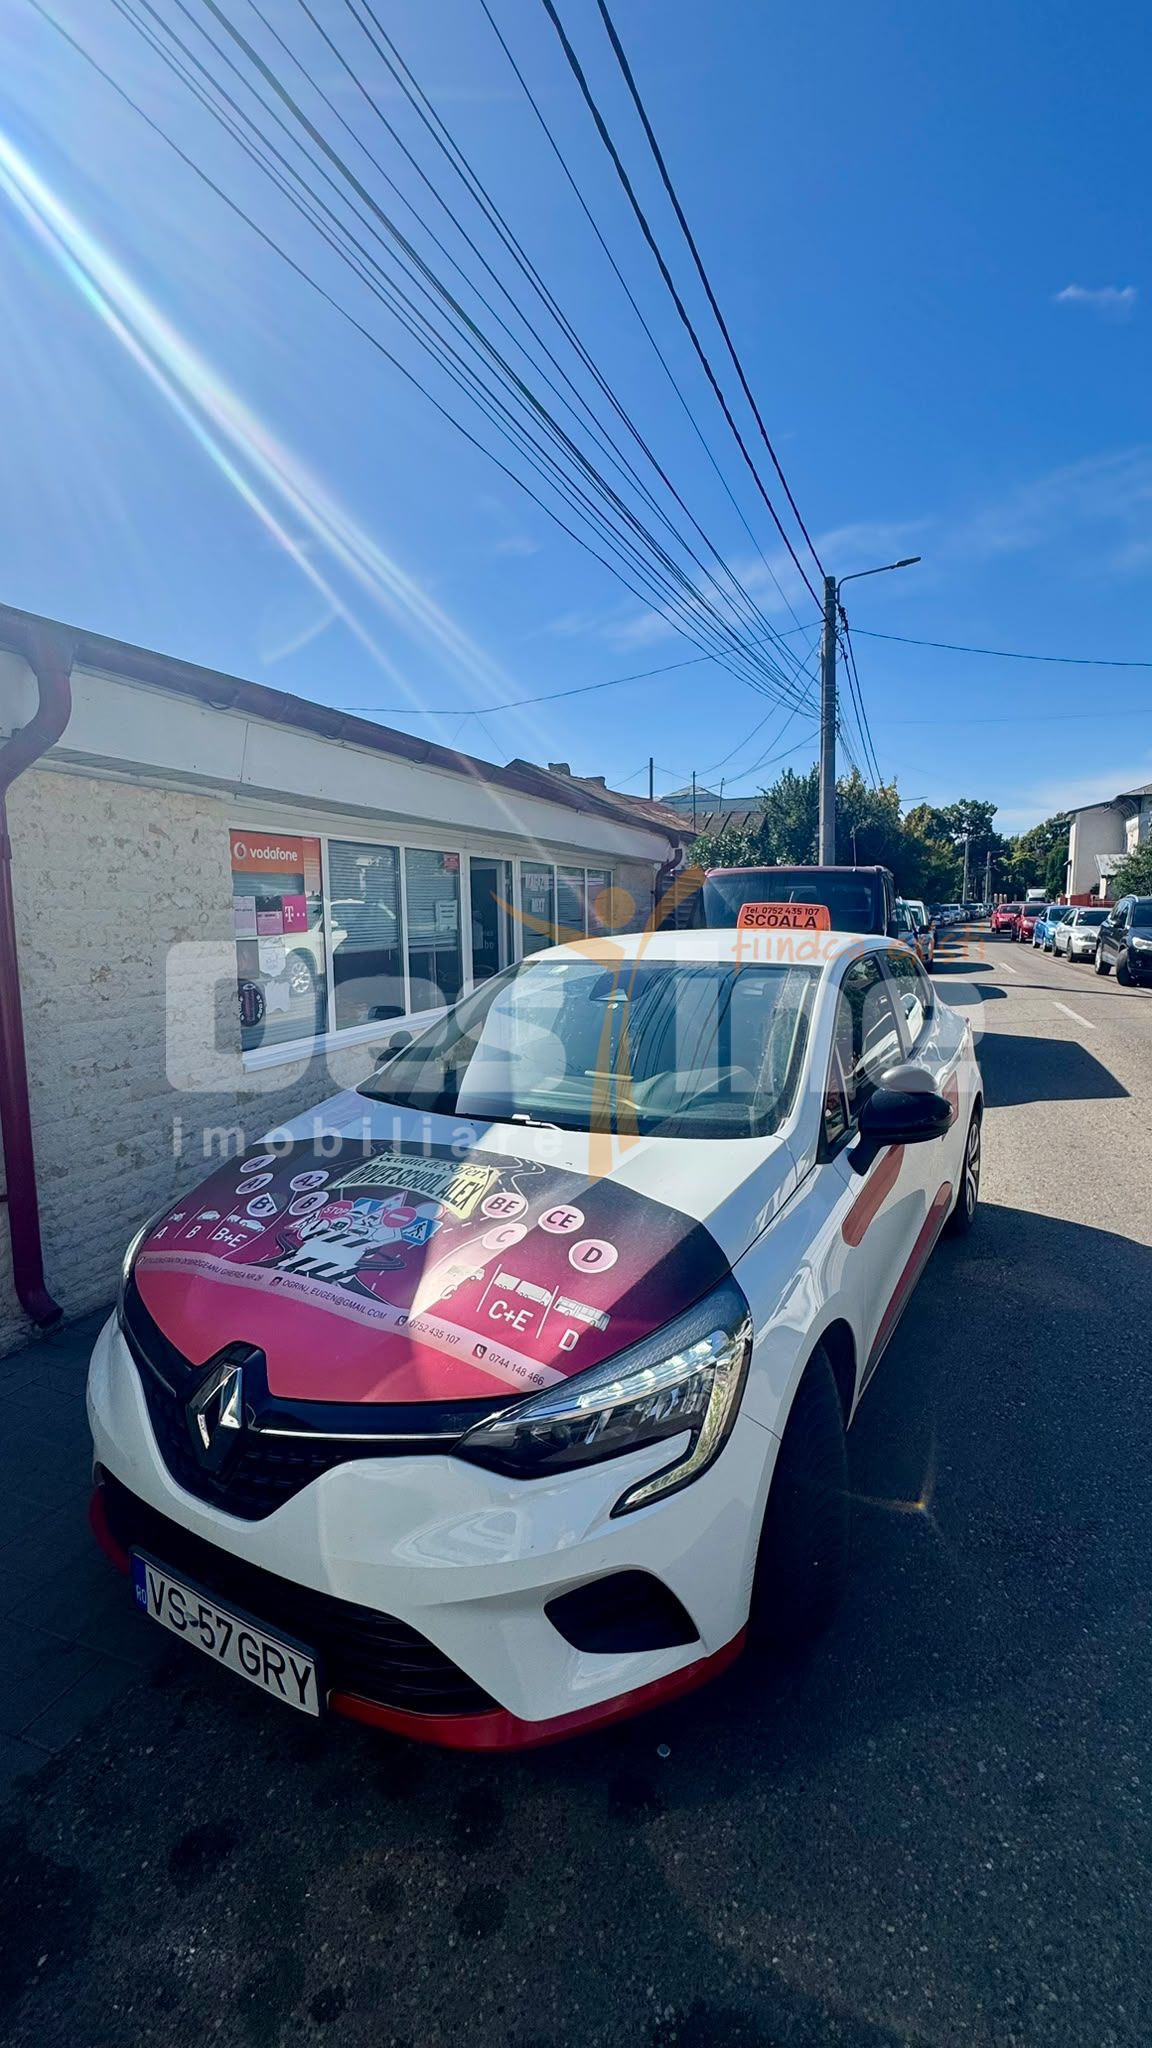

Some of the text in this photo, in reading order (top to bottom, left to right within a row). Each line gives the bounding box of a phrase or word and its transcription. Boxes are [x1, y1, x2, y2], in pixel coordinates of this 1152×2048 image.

[249, 846, 298, 861] vodafone
[746, 906, 759, 914] Tel.
[785, 907, 802, 915] 435
[804, 908, 820, 916] 107
[743, 914, 817, 928] SCOALA
[294, 1174, 323, 1187] A2
[388, 1169, 447, 1194] SCHOOL
[436, 1178, 484, 1210] ALEX
[251, 1197, 274, 1213] B1
[299, 1197, 318, 1209] B
[324, 1206, 348, 1216] STOP
[487, 1197, 519, 1214] BE
[546, 1210, 577, 1229] CE
[153, 1226, 168, 1239] A
[185, 1225, 201, 1238] B
[212, 1228, 248, 1247] B+E
[496, 1229, 515, 1243] C
[581, 1246, 603, 1263] D
[440, 1284, 458, 1300] C
[488, 1300, 534, 1332] C+E
[409, 1319, 461, 1345] 0752 435 107
[558, 1328, 580, 1352] D
[488, 1352, 545, 1386] 0744 148 466
[135, 1584, 147, 1605] RO
